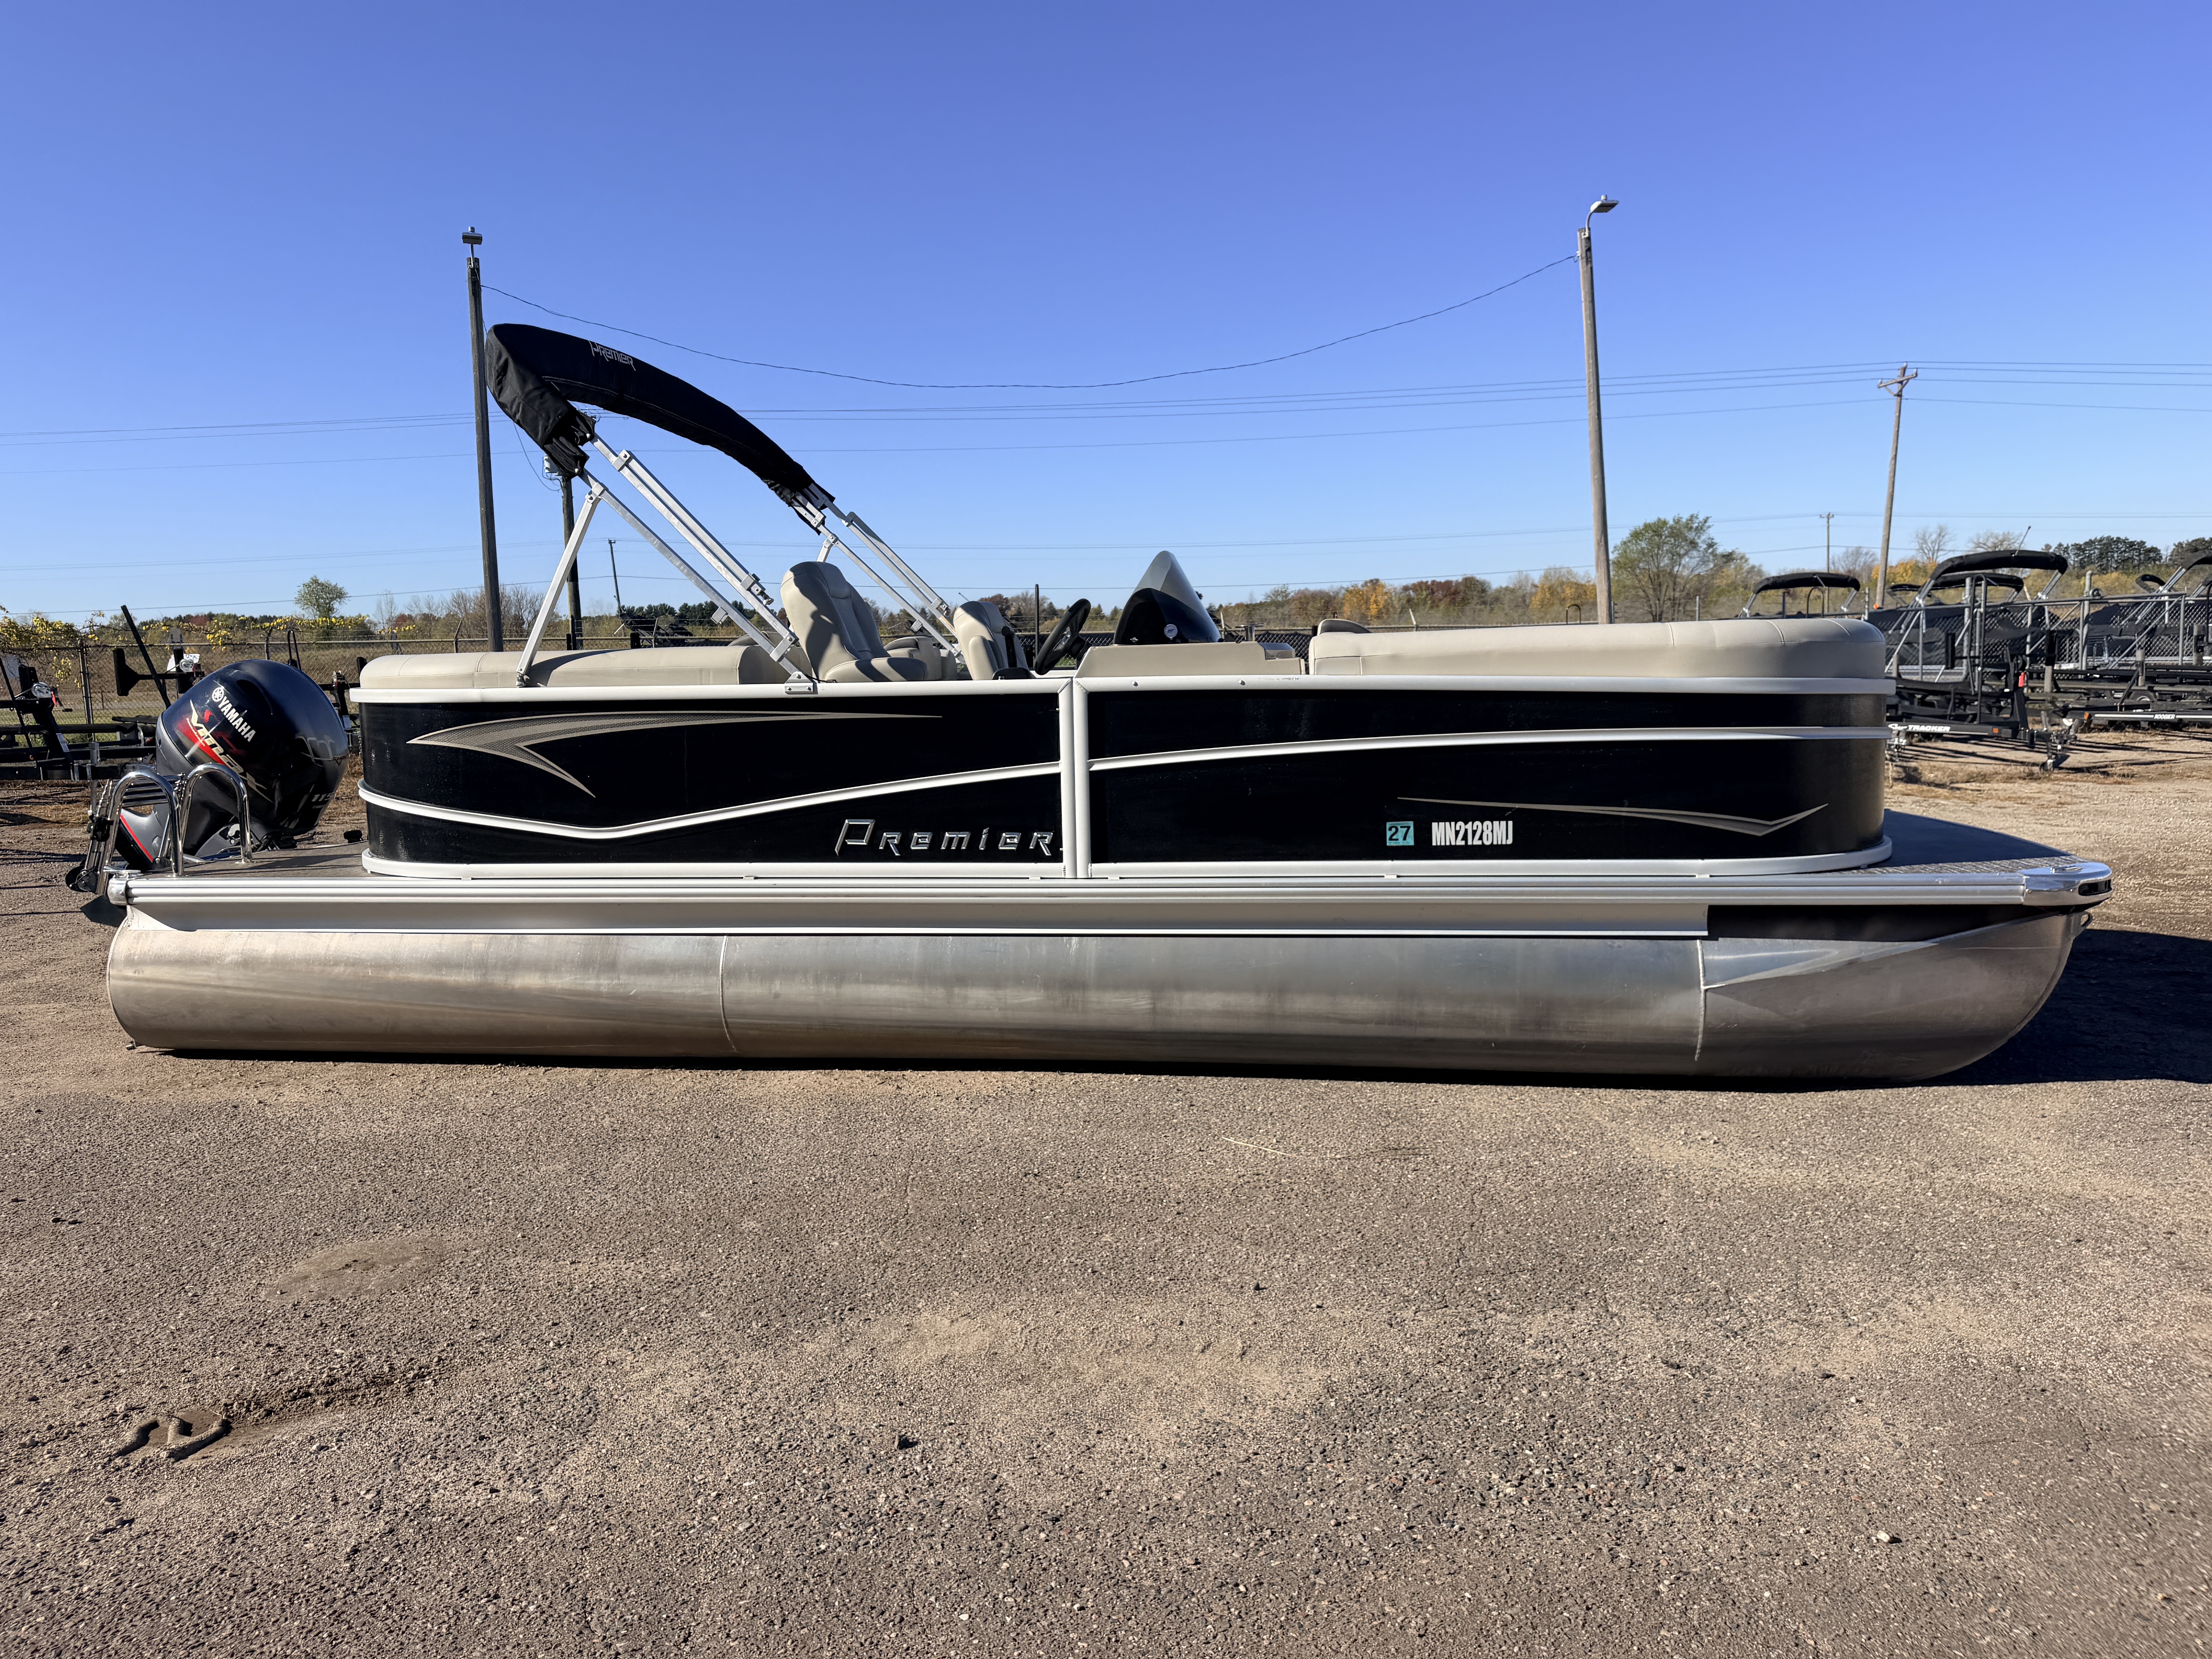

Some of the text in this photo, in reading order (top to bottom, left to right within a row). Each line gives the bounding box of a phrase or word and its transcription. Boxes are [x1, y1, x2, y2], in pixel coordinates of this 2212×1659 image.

[218, 696, 256, 742] YAMAHA
[1388, 825, 1411, 841] 27
[1432, 821, 1513, 846] MN2128MJ
